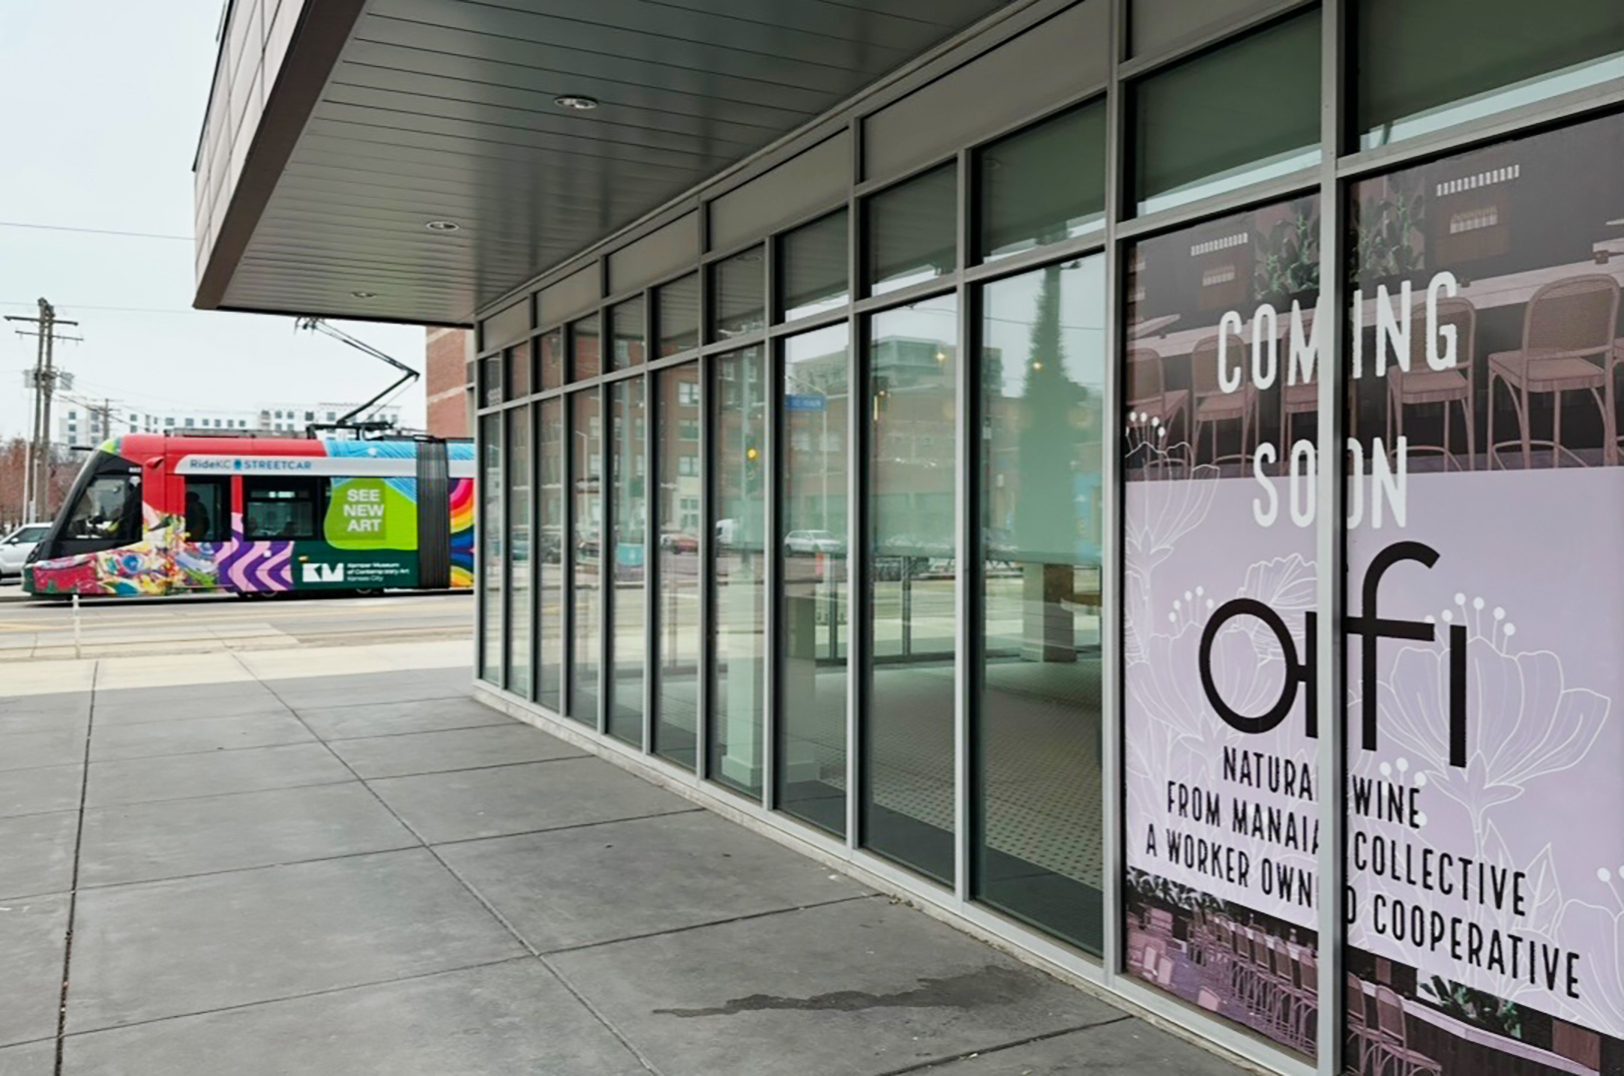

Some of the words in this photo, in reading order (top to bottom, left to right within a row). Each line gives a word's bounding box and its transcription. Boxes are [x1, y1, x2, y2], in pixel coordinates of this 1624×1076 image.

[1217, 271, 1458, 393] COMING
[190, 460, 231, 469] RideKC
[244, 461, 312, 470] STREETCAR
[347, 489, 380, 502] SEE
[1253, 436, 1407, 530] SOON
[343, 504, 385, 517] NEW
[347, 519, 382, 532] ART
[1224, 746, 1318, 801] NATURA
[1353, 775, 1420, 829] WINE
[1168, 780, 1220, 827] FROM
[1355, 831, 1526, 916] COLLECTIVE
[1147, 824, 1157, 857] A
[1167, 829, 1250, 888] WORKER
[1262, 858, 1356, 924] OWND
[1374, 894, 1580, 999] COOPERATIVE
